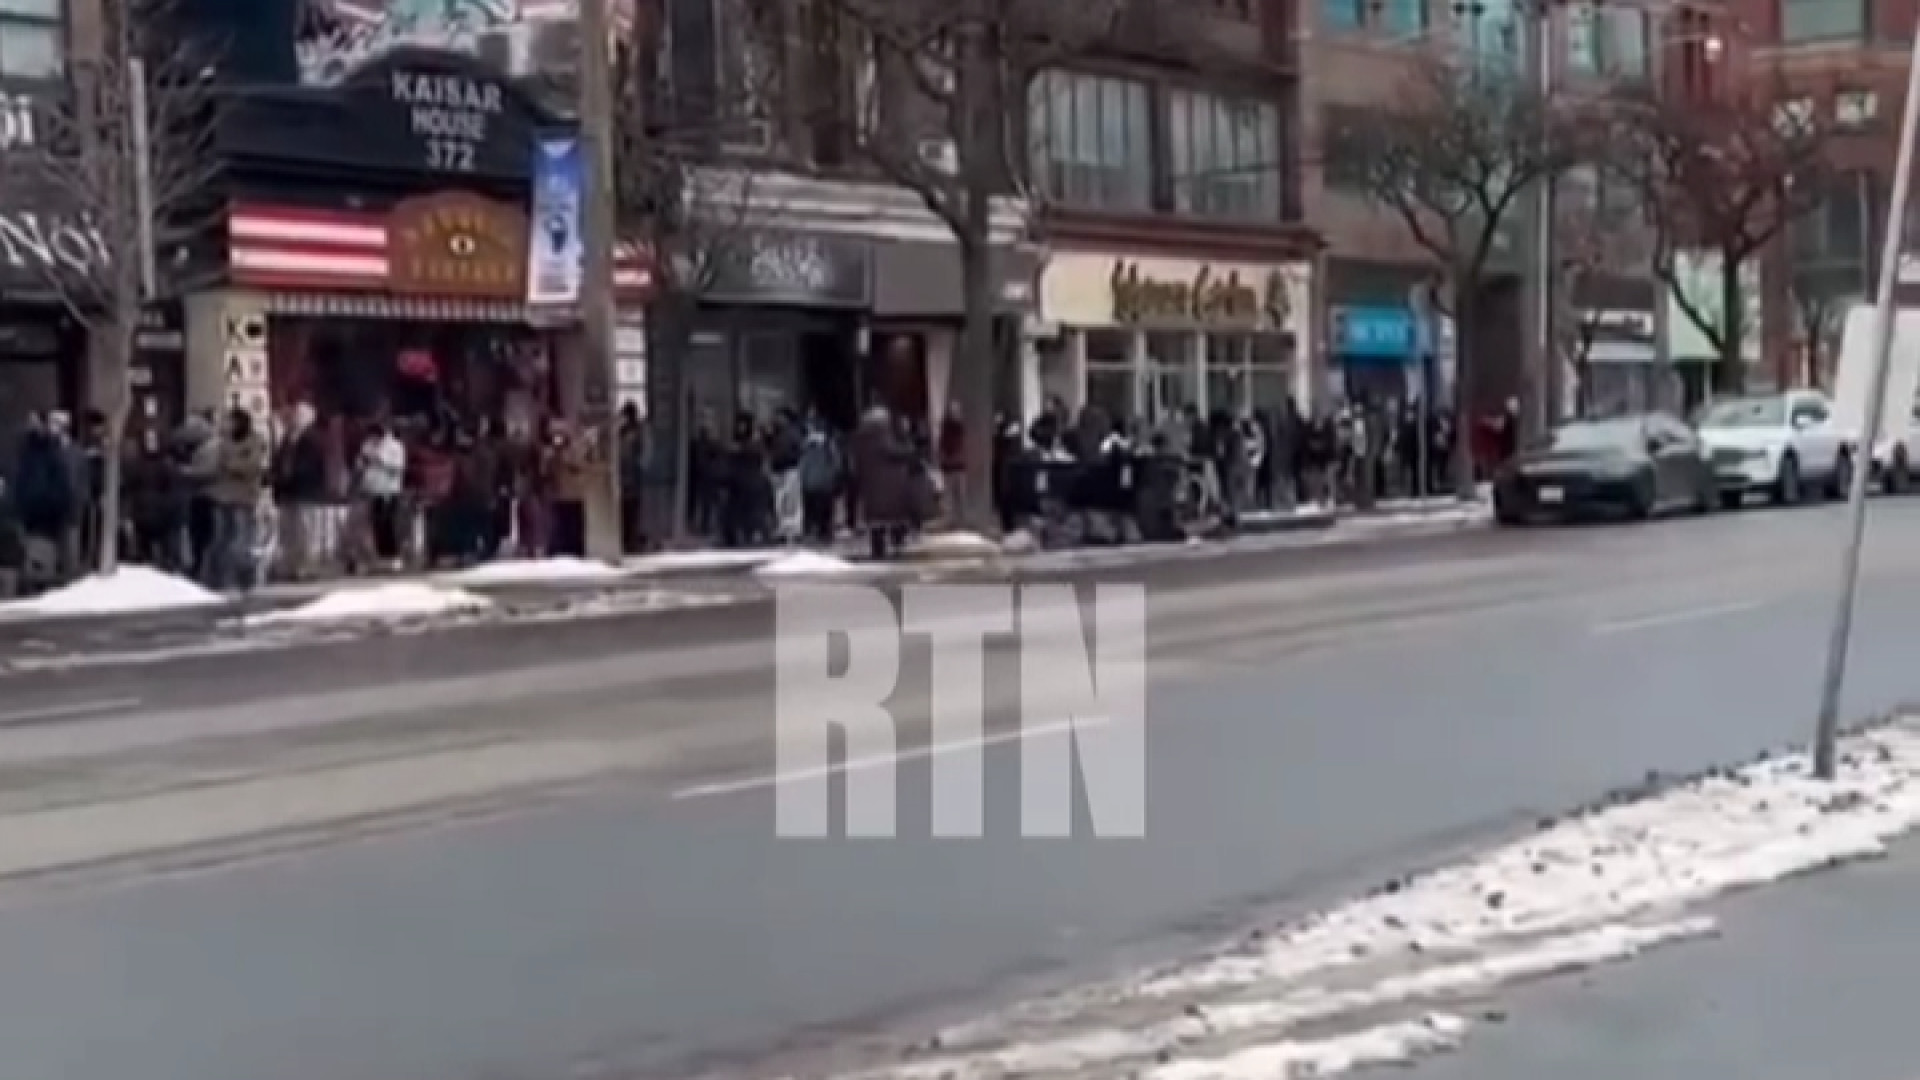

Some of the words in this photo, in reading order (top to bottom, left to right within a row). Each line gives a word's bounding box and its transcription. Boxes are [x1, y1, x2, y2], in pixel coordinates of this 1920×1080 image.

[392, 72, 501, 111] KAISAR
[411, 107, 485, 139] HOUSE
[426, 141, 473, 170] 372
